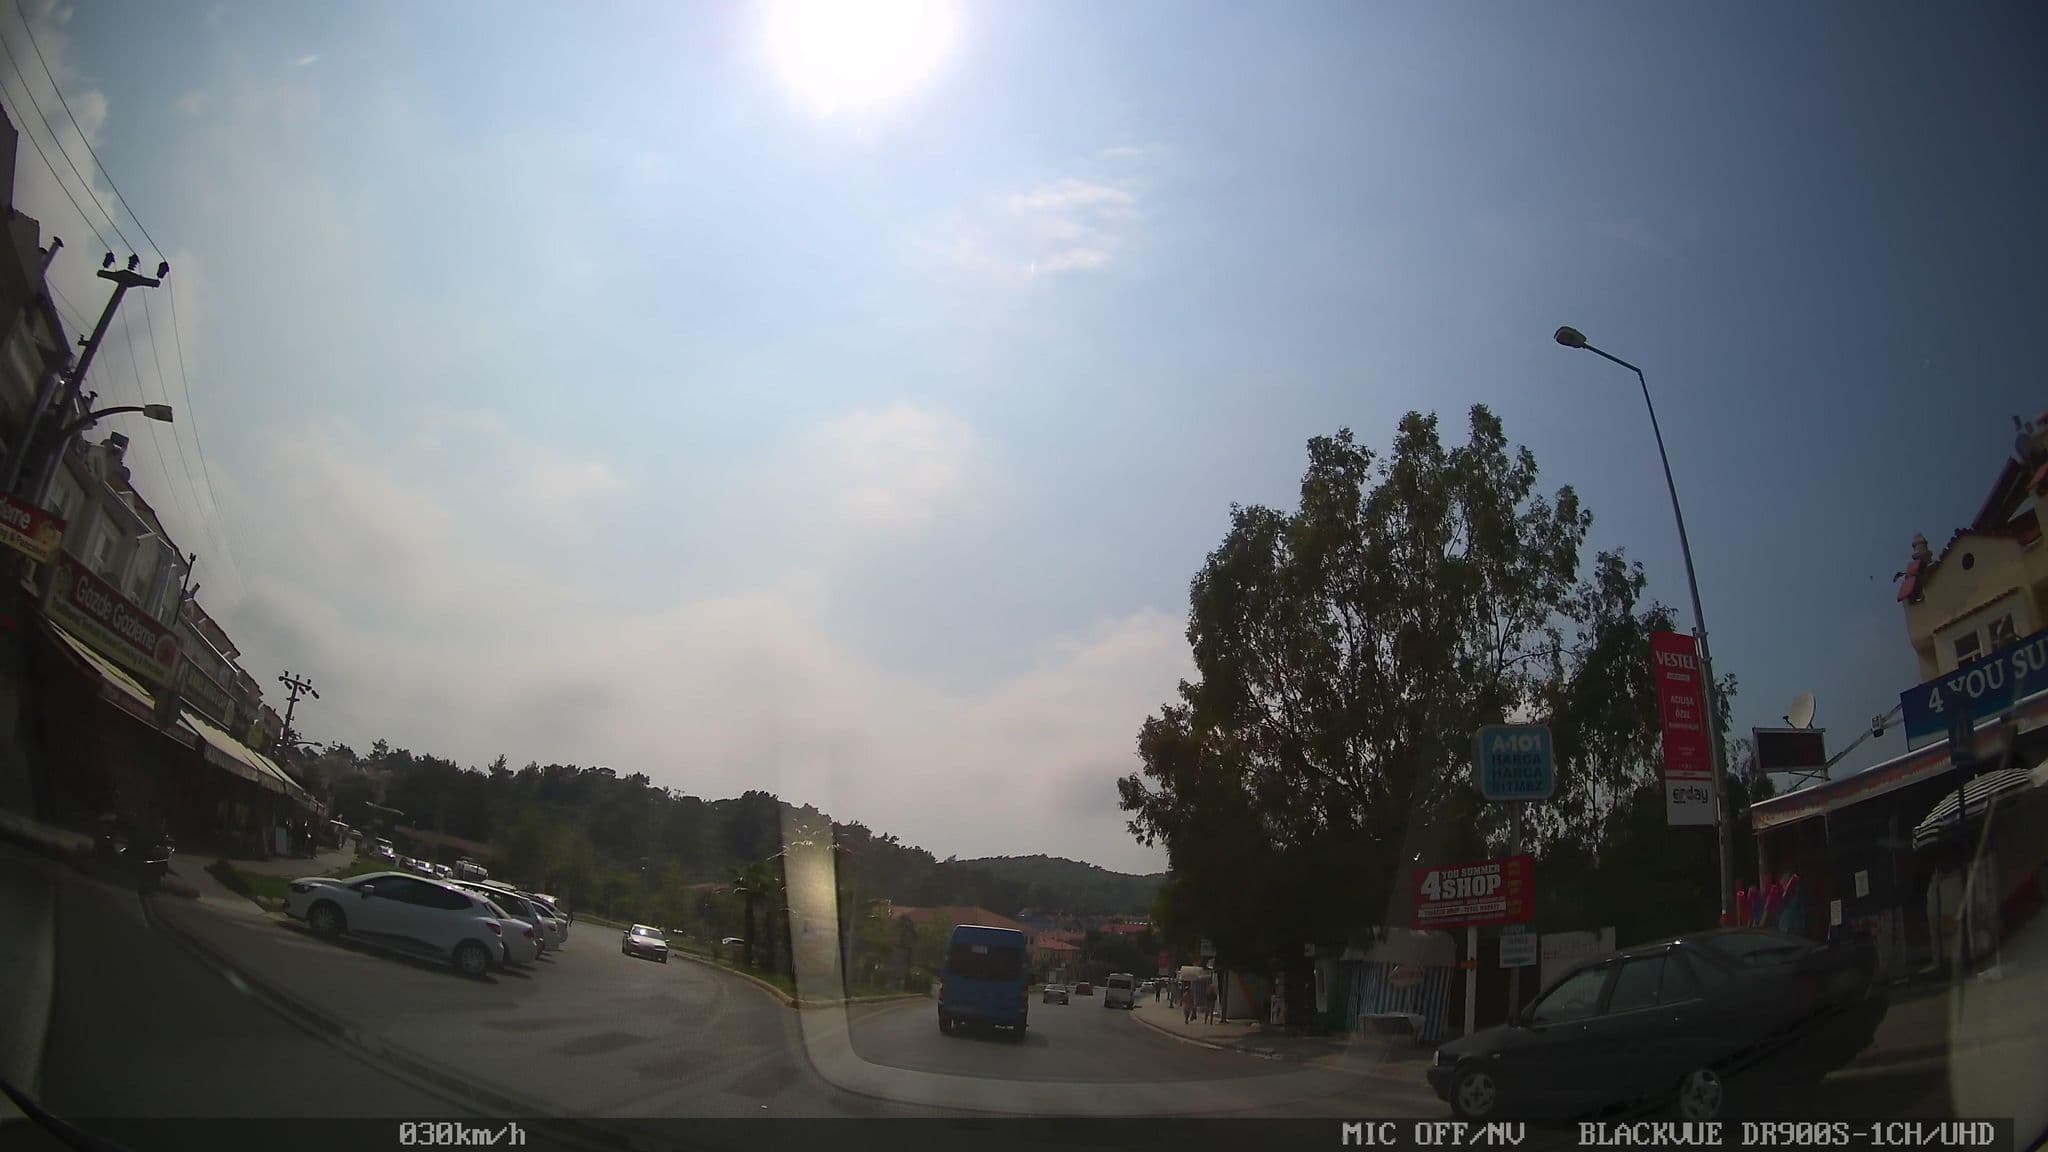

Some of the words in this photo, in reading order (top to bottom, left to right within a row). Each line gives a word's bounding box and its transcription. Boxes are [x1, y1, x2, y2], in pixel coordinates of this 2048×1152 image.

[1656, 650, 1697, 670] VESTEL
[1928, 687, 1944, 713] 4
[1441, 869, 1459, 879] YOU
[1461, 864, 1501, 877] SUMMER
[1420, 871, 1441, 901] 4
[1441, 874, 1501, 900] SHOP
